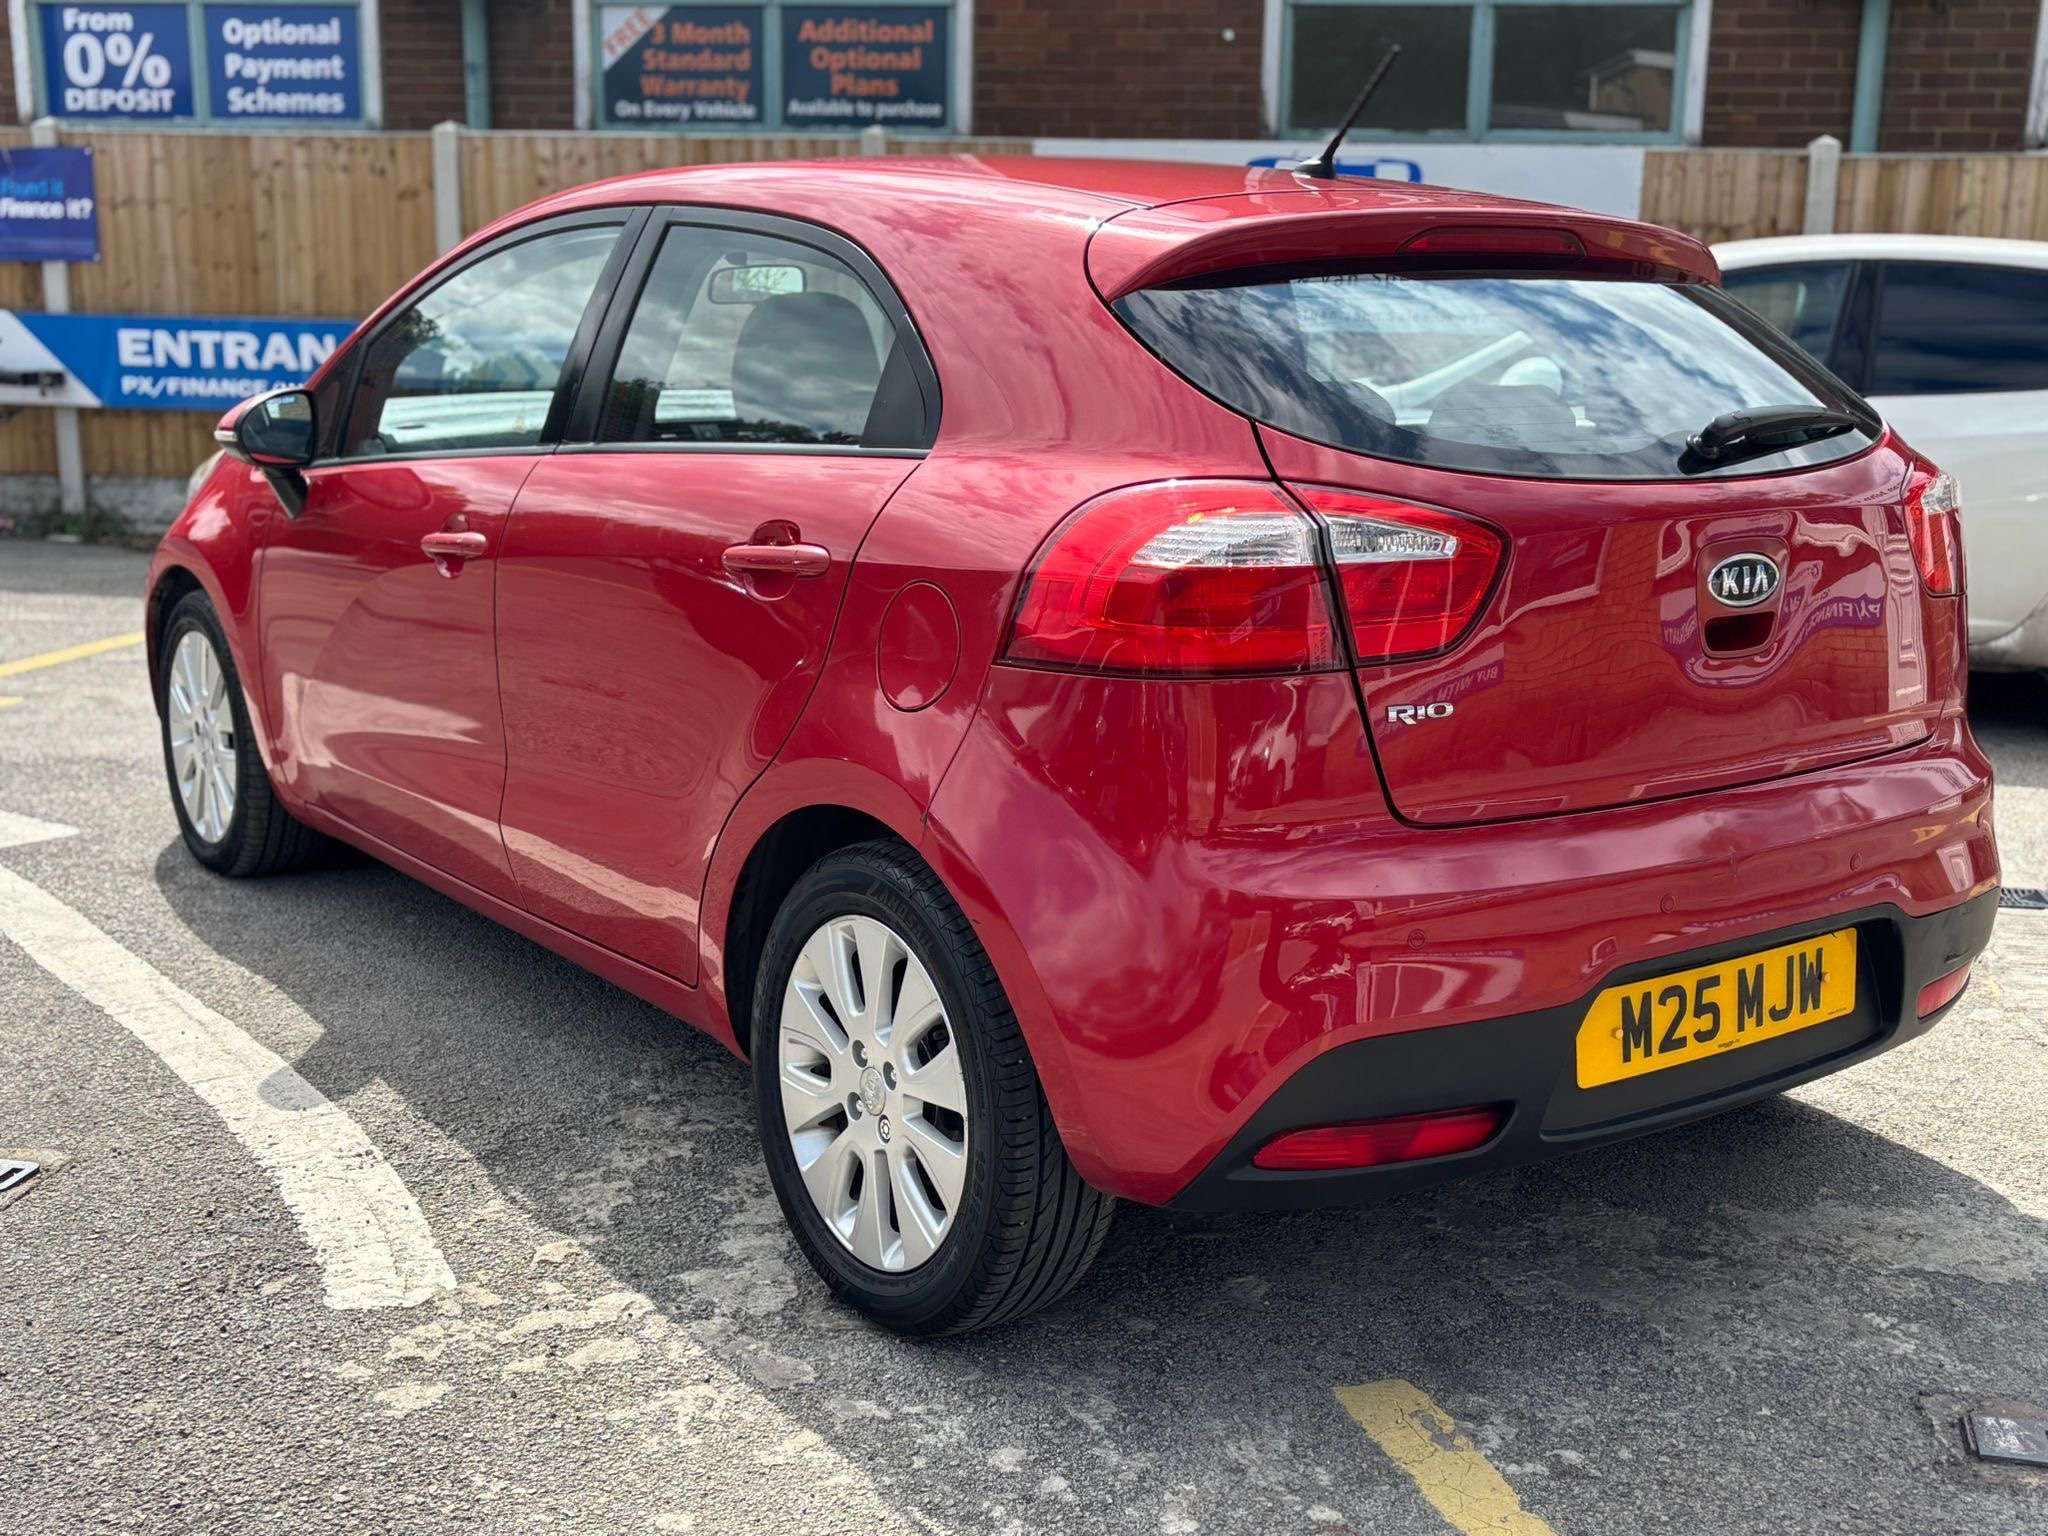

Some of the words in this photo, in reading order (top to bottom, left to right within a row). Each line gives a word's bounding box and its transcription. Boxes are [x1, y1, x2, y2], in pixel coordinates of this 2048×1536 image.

[63, 8, 134, 31] From
[604, 8, 649, 55] FREE
[672, 20, 752, 45] Month
[798, 18, 935, 43] Additional
[222, 18, 340, 49] Optional
[63, 33, 171, 88] 0%
[224, 53, 345, 84] Payment
[642, 47, 752, 72] Standard
[810, 47, 923, 73] Optional
[639, 74, 751, 104] Warranty
[831, 74, 898, 97] Plans
[64, 88, 175, 112] DEPOSIT
[227, 87, 345, 114] Schemes
[614, 100, 641, 118] On
[643, 100, 691, 122] Every
[693, 101, 757, 119] Vehicle
[787, 98, 854, 117] Available
[856, 99, 874, 117] to
[875, 98, 944, 121] purchase
[117, 328, 337, 373] ENTRAN
[1721, 564, 1769, 596] KIA
[1387, 701, 1455, 725] RIO
[1620, 974, 1721, 1064] M25
[1736, 947, 1823, 1032] MJW
